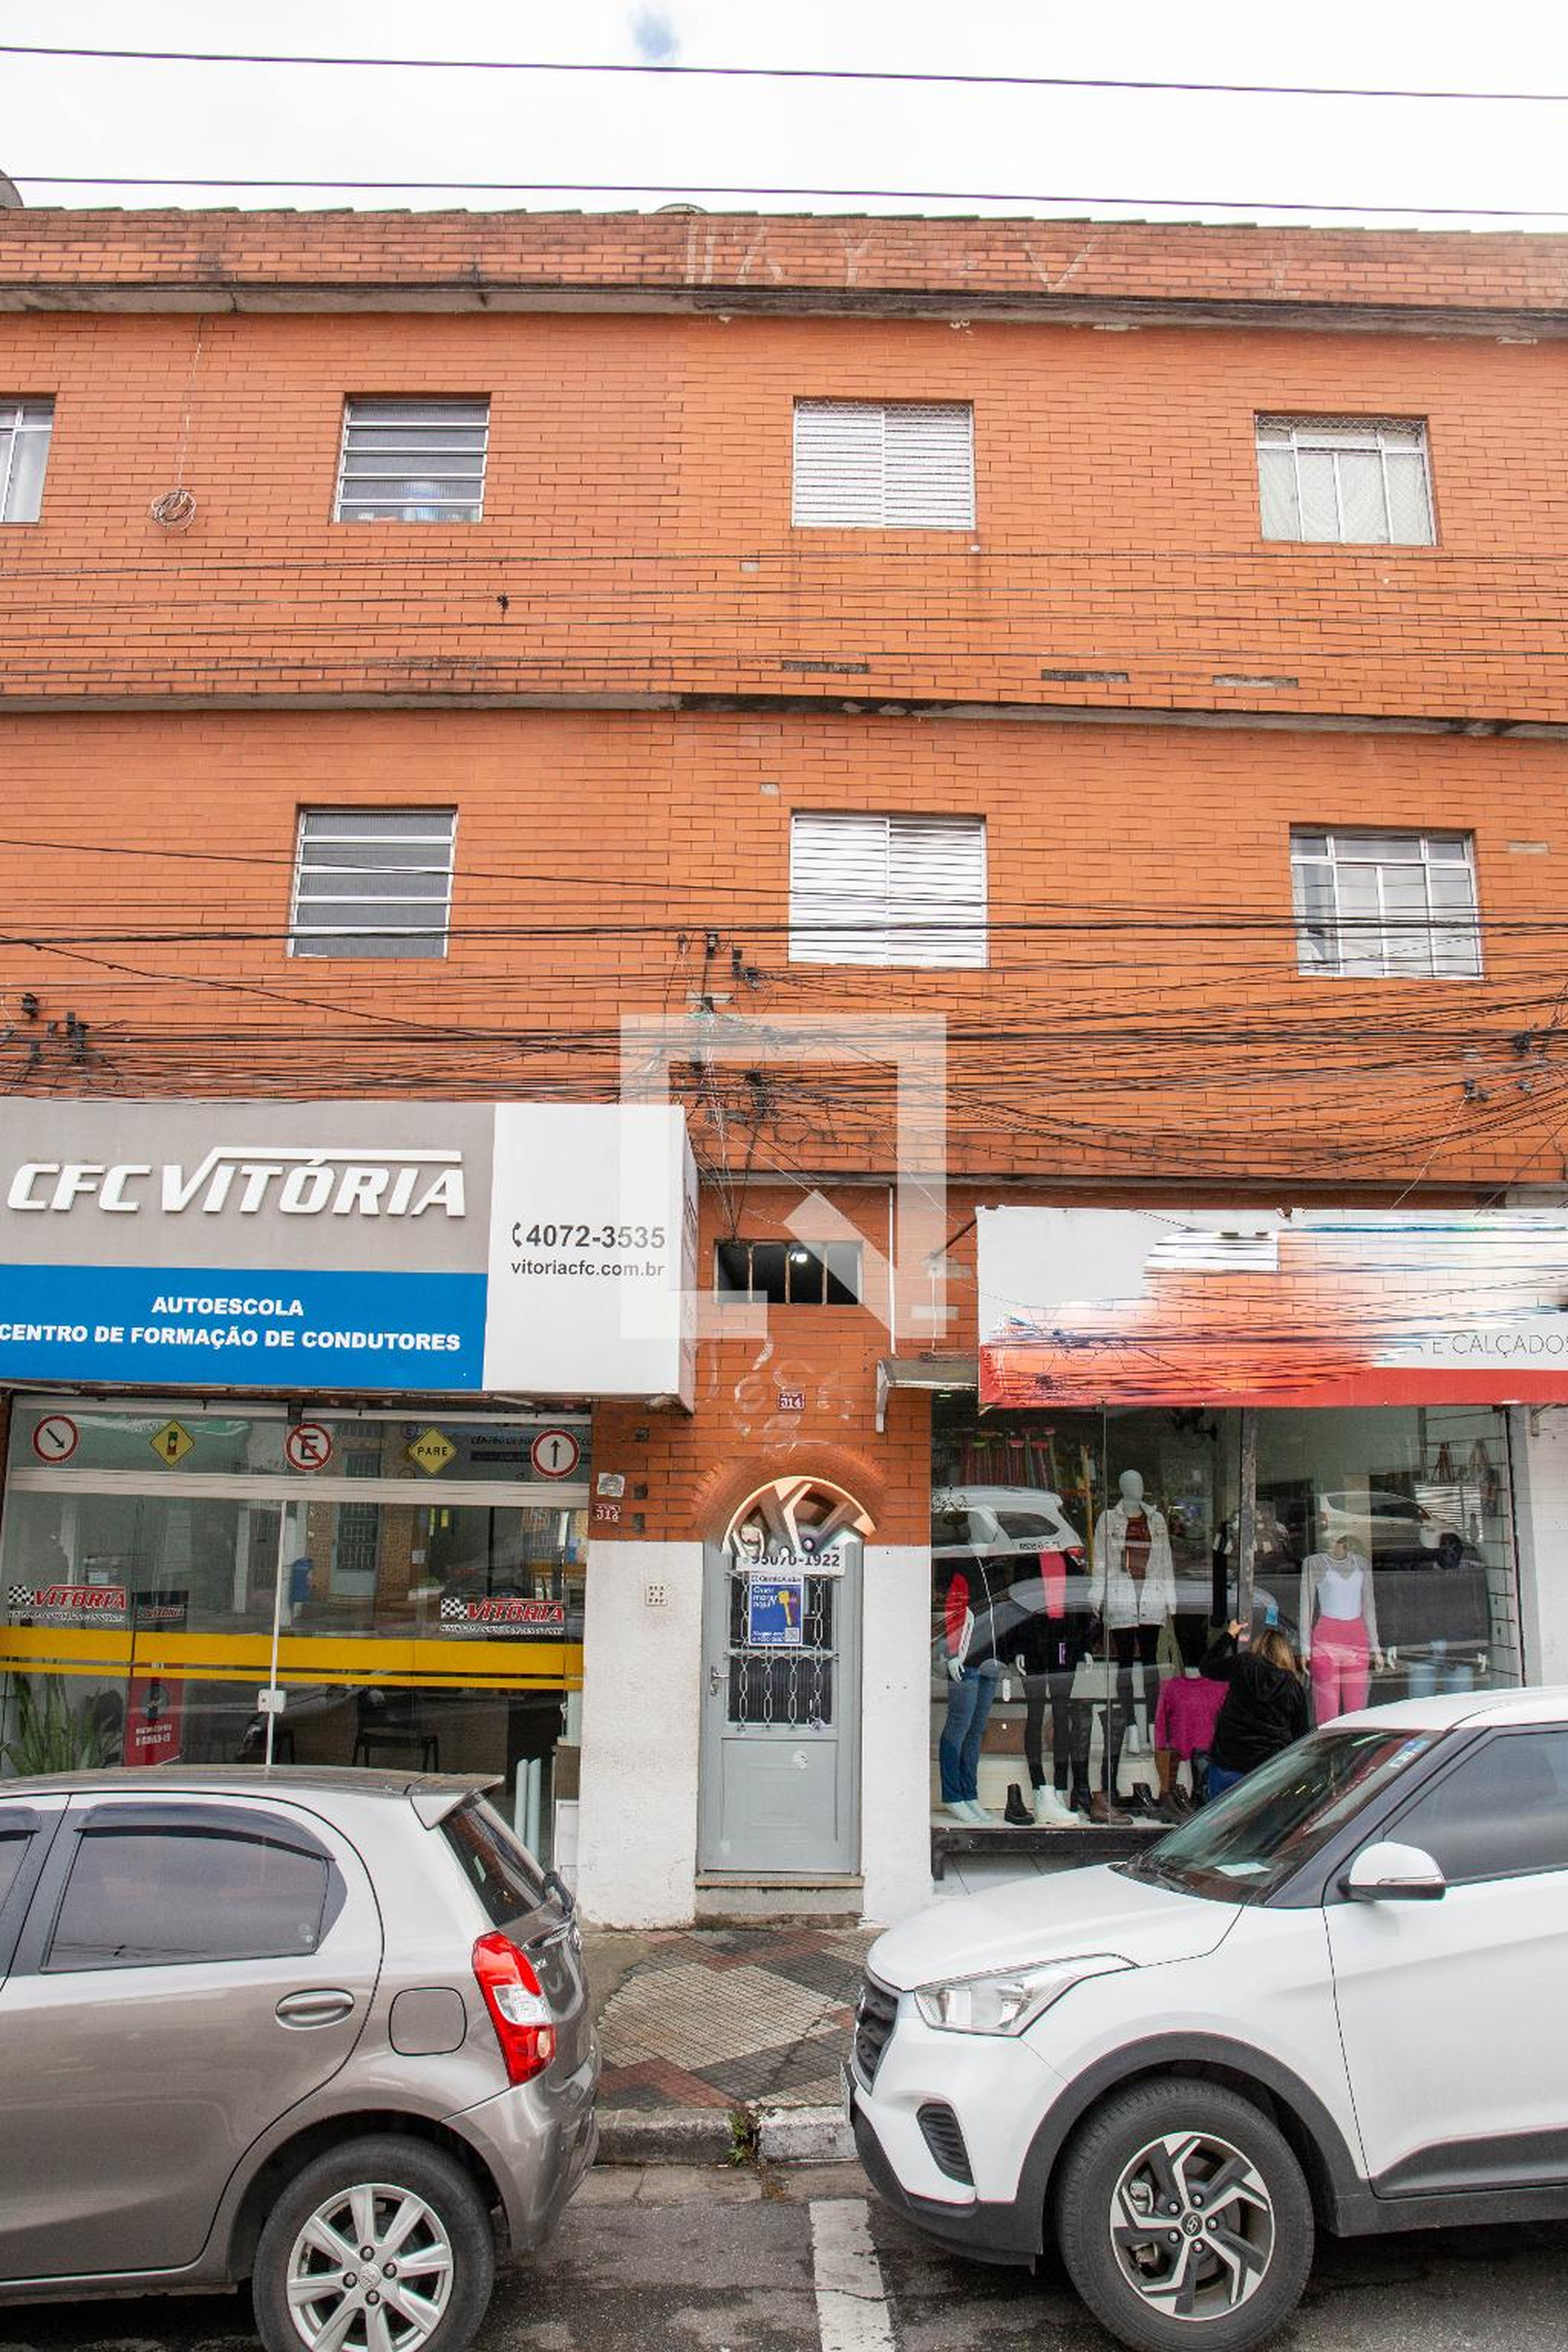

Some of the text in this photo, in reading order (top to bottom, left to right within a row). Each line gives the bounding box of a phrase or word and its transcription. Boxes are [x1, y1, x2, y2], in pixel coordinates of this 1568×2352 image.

[7, 1147, 466, 1217] CFC VITÓRIA
[526, 1225, 666, 1249] 4072-3535
[511, 1259, 665, 1277] vitoriacfc.com.br
[151, 1296, 303, 1316] AUTOESCOLA
[0, 1324, 460, 1351] CENTRO DE FORMAÇÃO DE CONDUTORES
[1452, 1334, 1568, 1358] CALÇADO
[417, 1446, 448, 1456] PARE
